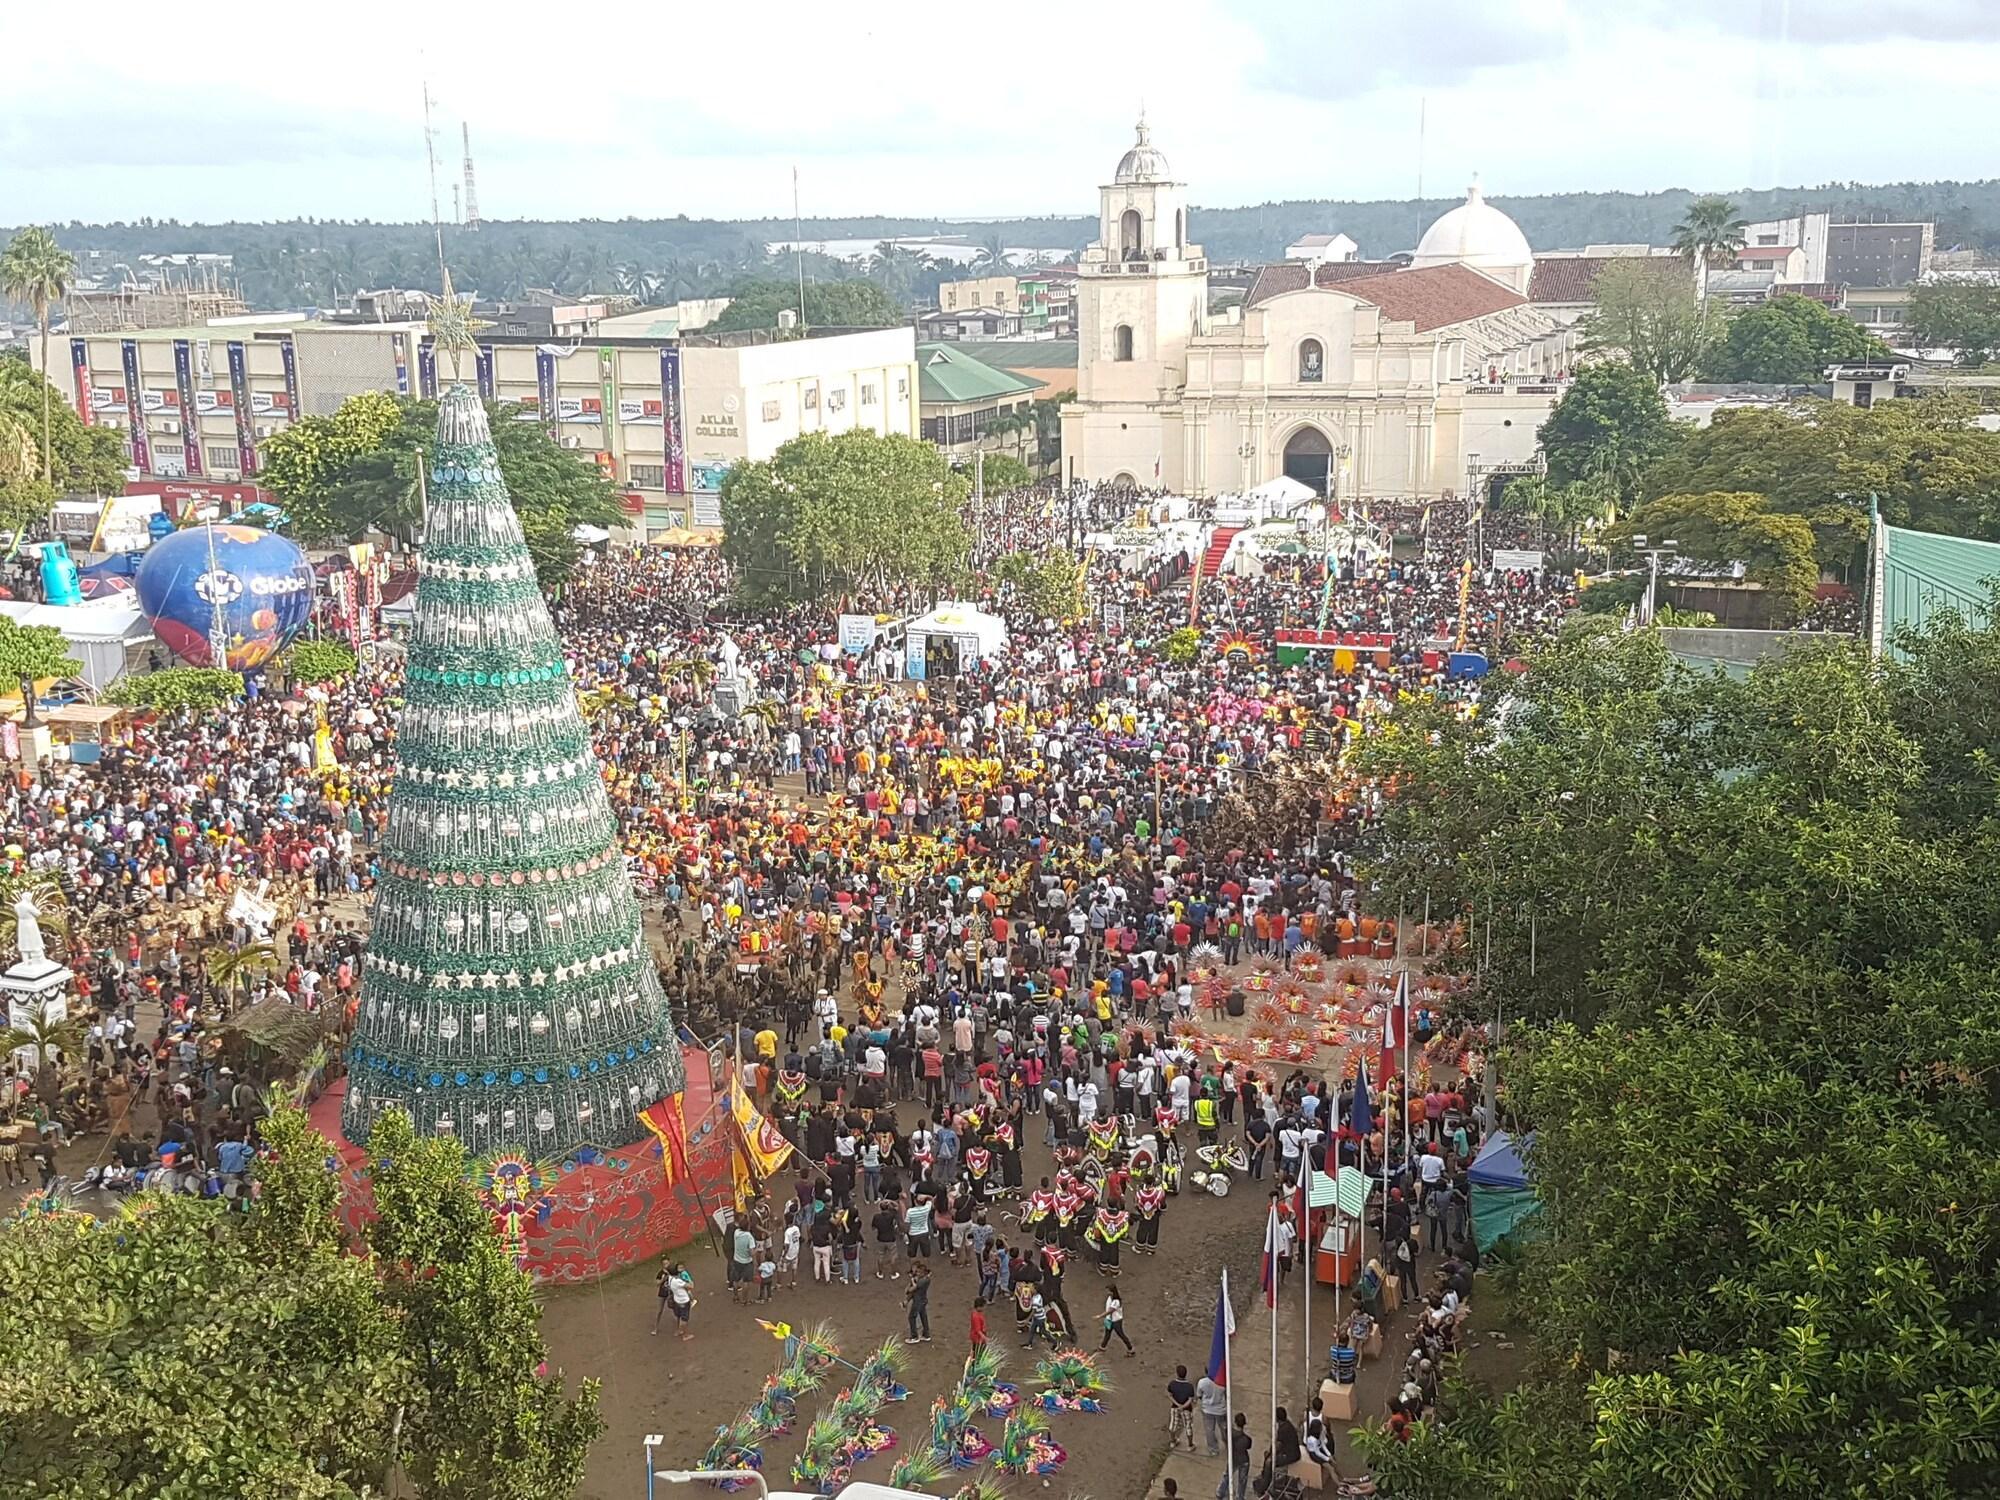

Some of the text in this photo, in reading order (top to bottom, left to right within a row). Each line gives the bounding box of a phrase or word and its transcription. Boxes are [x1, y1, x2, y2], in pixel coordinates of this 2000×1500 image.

[700, 414, 734, 425] AKLAN
[695, 426, 739, 437] COLLEGE
[250, 575, 307, 595] Globe
